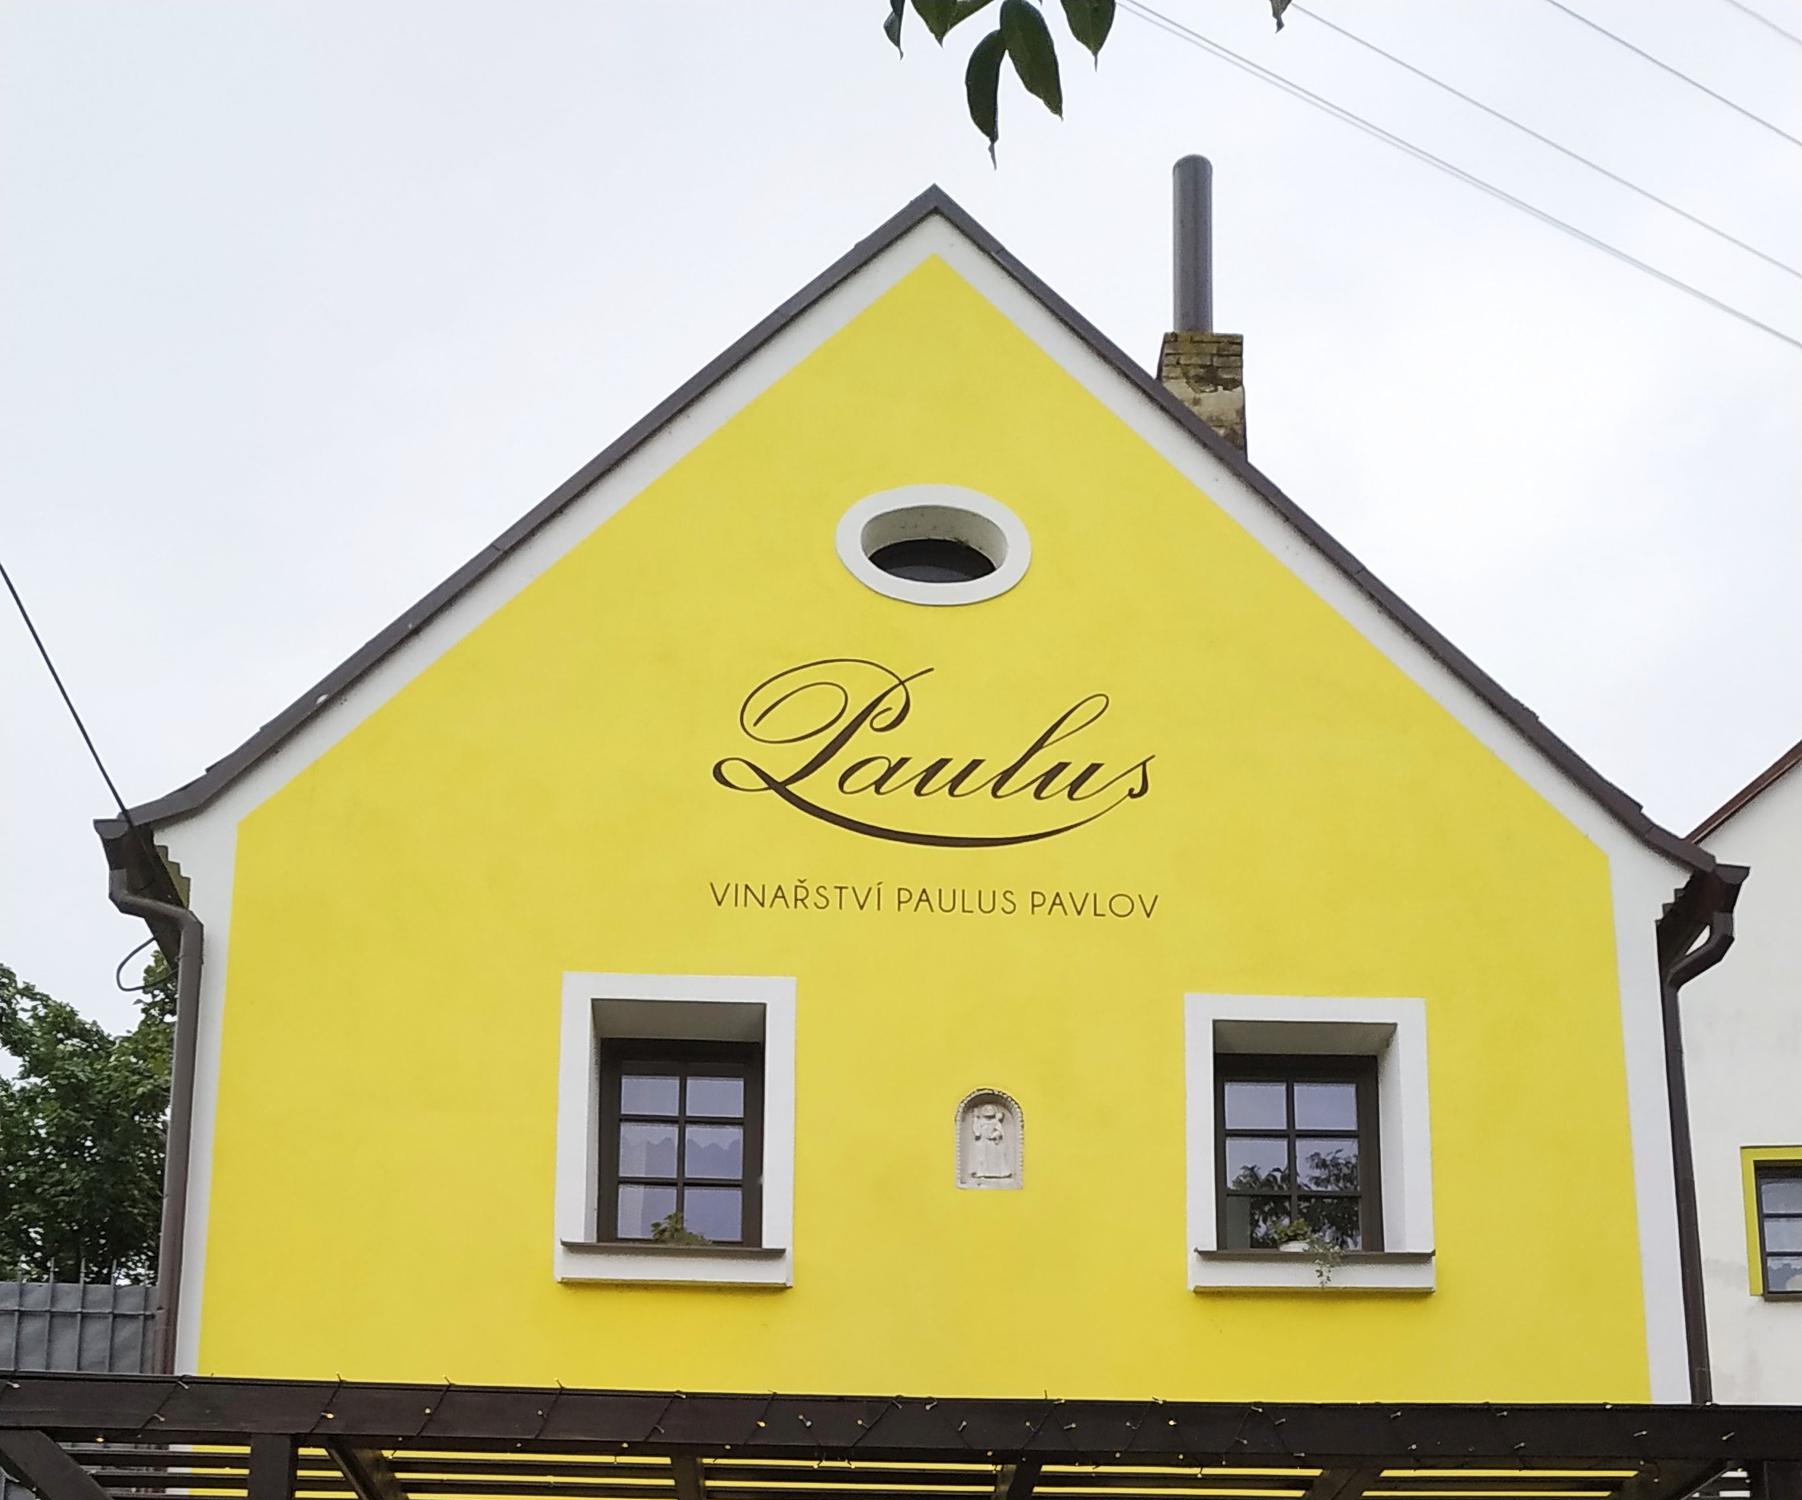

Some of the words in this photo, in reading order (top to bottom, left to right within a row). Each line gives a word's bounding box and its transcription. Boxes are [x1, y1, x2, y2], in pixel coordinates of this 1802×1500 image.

[712, 658, 1156, 848] Paulus
[709, 878, 883, 911] VINAŘSTVÍ
[897, 887, 1016, 914] PAULUS
[1031, 890, 1159, 918] PAVLOV
